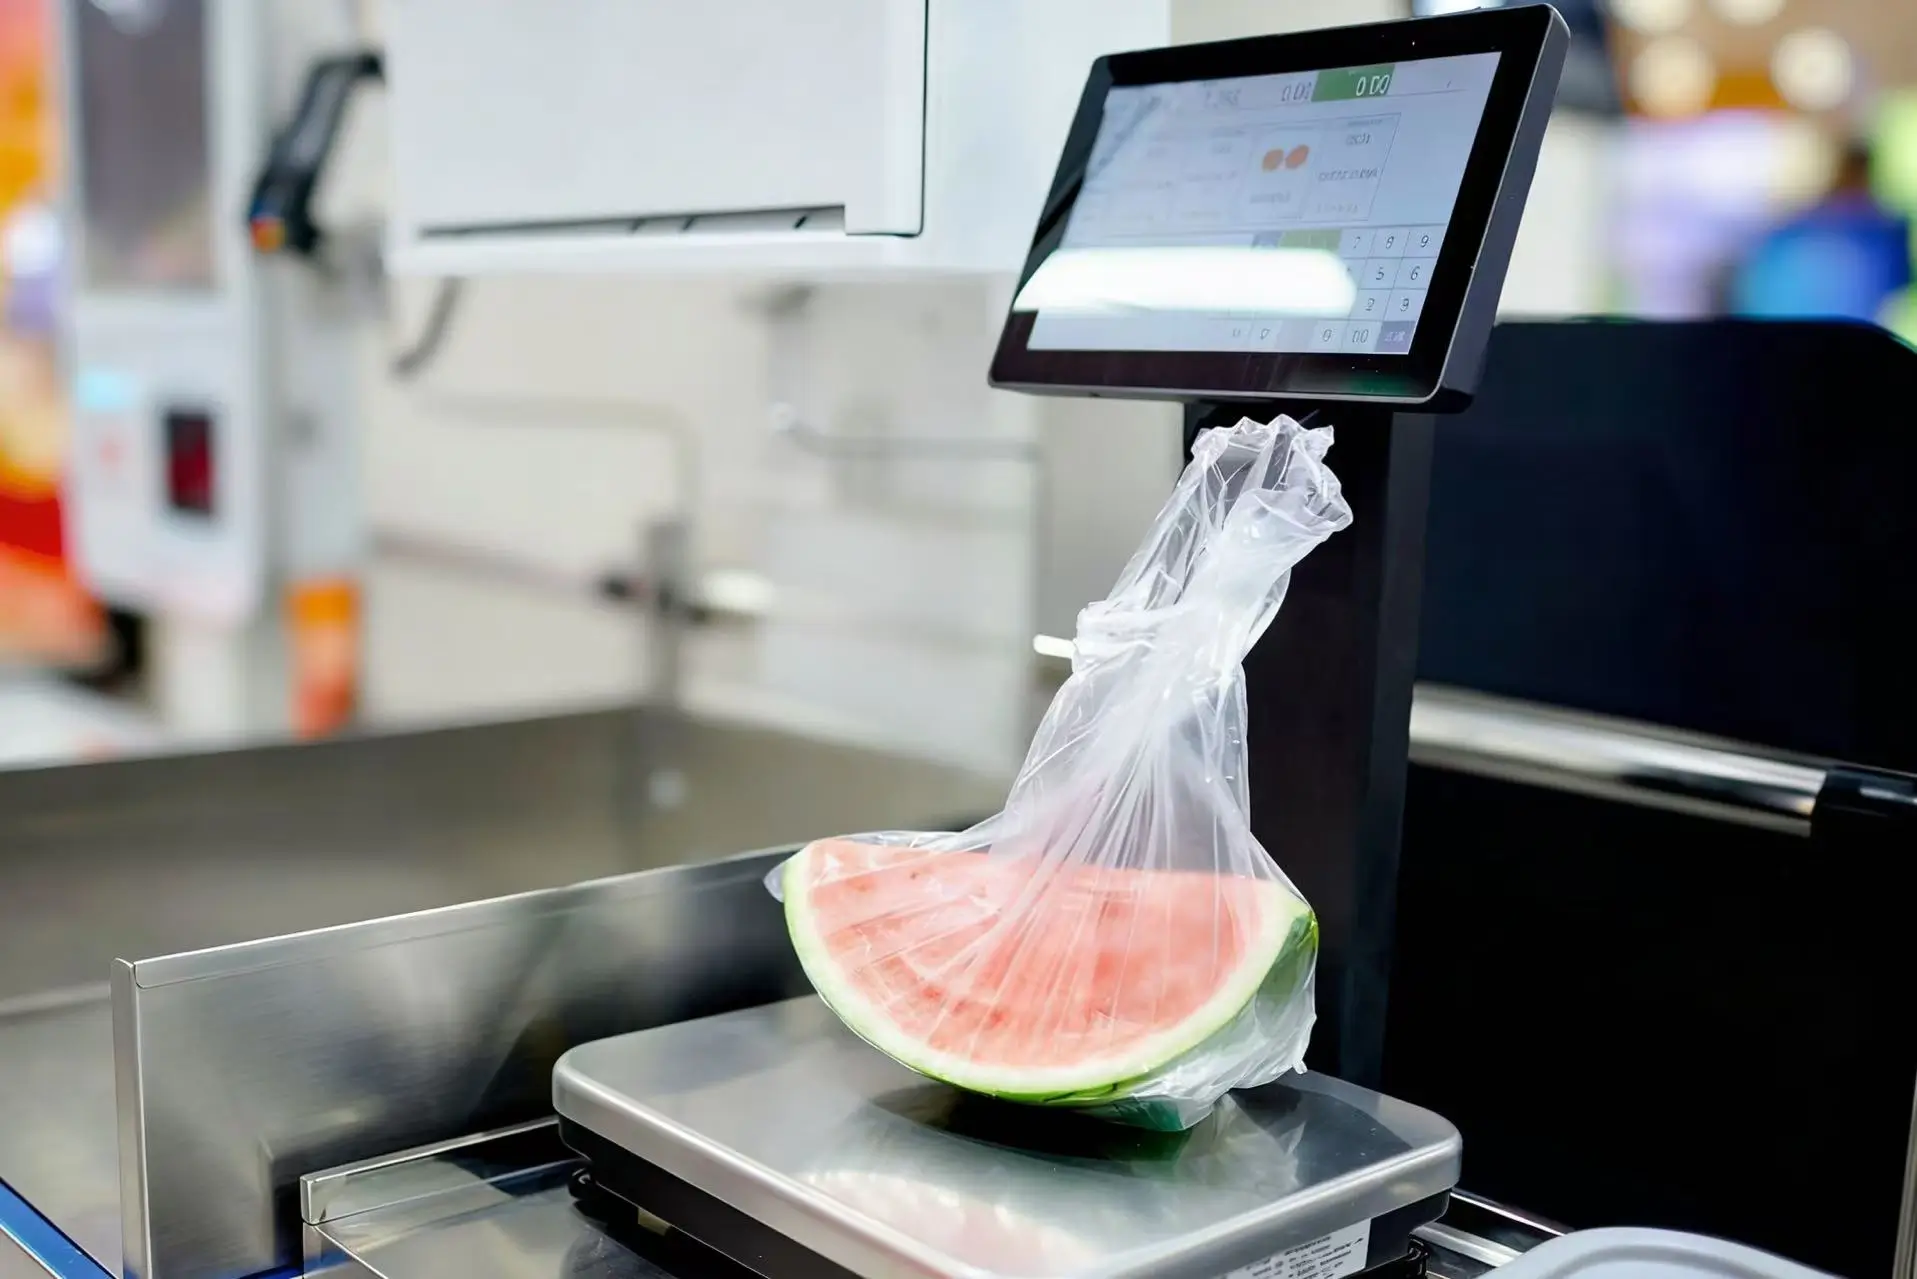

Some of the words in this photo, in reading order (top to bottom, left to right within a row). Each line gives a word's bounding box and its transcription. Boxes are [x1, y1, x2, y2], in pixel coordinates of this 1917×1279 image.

[1355, 74, 1390, 97] 000
[1420, 234, 1430, 248] 9
[1375, 266, 1385, 281] 5
[1410, 265, 1421, 281] 6
